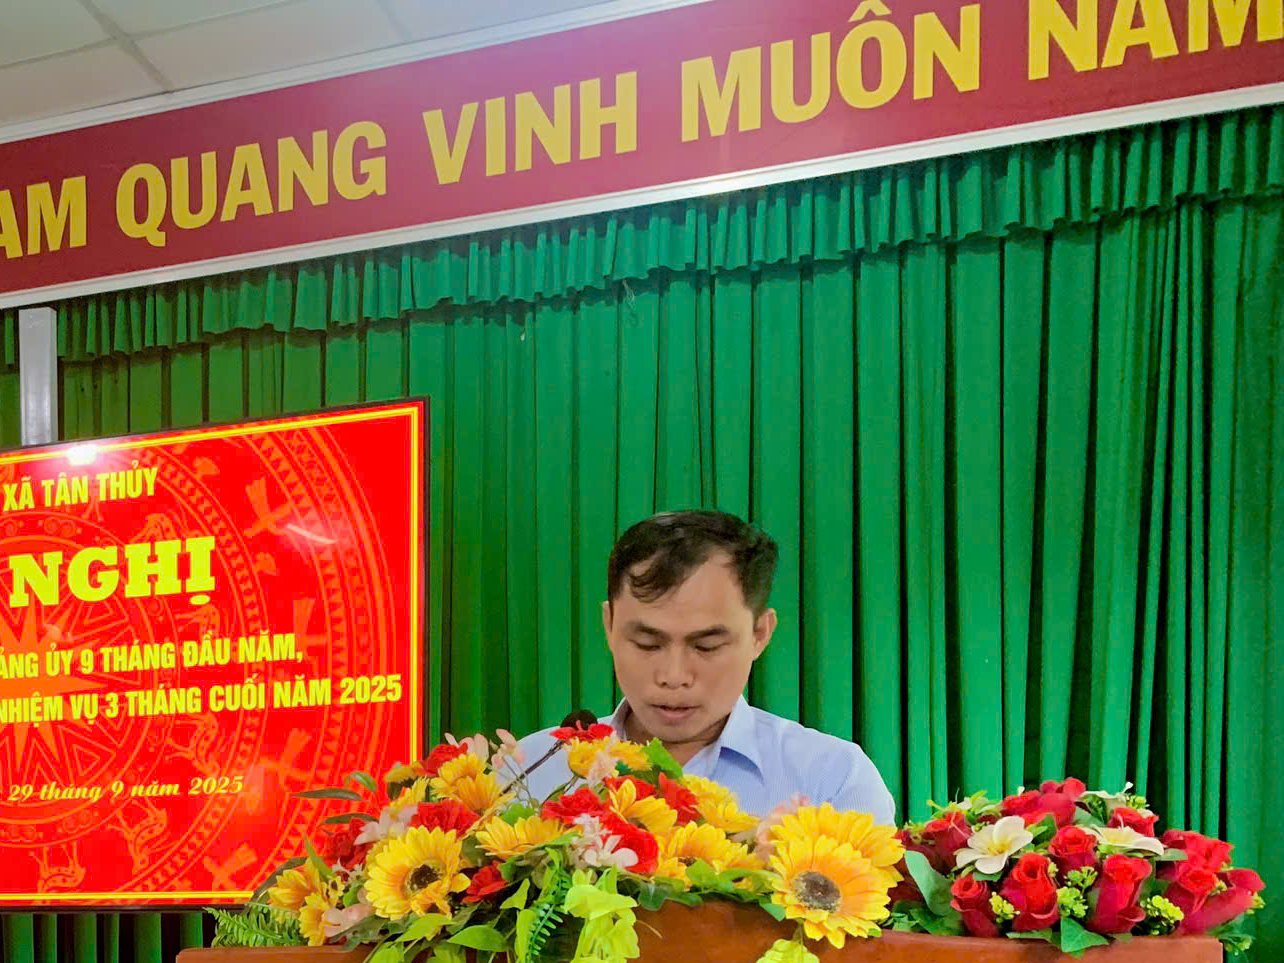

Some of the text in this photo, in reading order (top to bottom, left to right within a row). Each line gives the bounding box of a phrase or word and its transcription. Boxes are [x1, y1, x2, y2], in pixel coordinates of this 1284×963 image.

[115, 120, 387, 247] QUANG
[422, 70, 637, 185] VINH
[681, 0, 980, 142] MUÔN
[3, 475, 35, 511] XÃ
[41, 472, 89, 508] TÂN
[96, 460, 158, 502] THỦY
[9, 535, 216, 608] NGHỊ
[45, 643, 73, 677] ỦY
[80, 651, 95, 675] 9
[100, 640, 176, 673] THÁNG
[183, 630, 231, 668] ĐẦU
[238, 630, 304, 664] NĂM,
[70, 693, 100, 725] VỤ
[105, 693, 120, 719] 3
[125, 684, 203, 717] THÁNG
[209, 673, 267, 713] CUỐI
[273, 674, 332, 709] NĂM
[340, 674, 403, 705] 2025
[7, 783, 35, 803] 29
[39, 780, 103, 804] tháng
[110, 780, 126, 801] 9
[130, 780, 180, 797] năm
[187, 774, 245, 796] 2025
